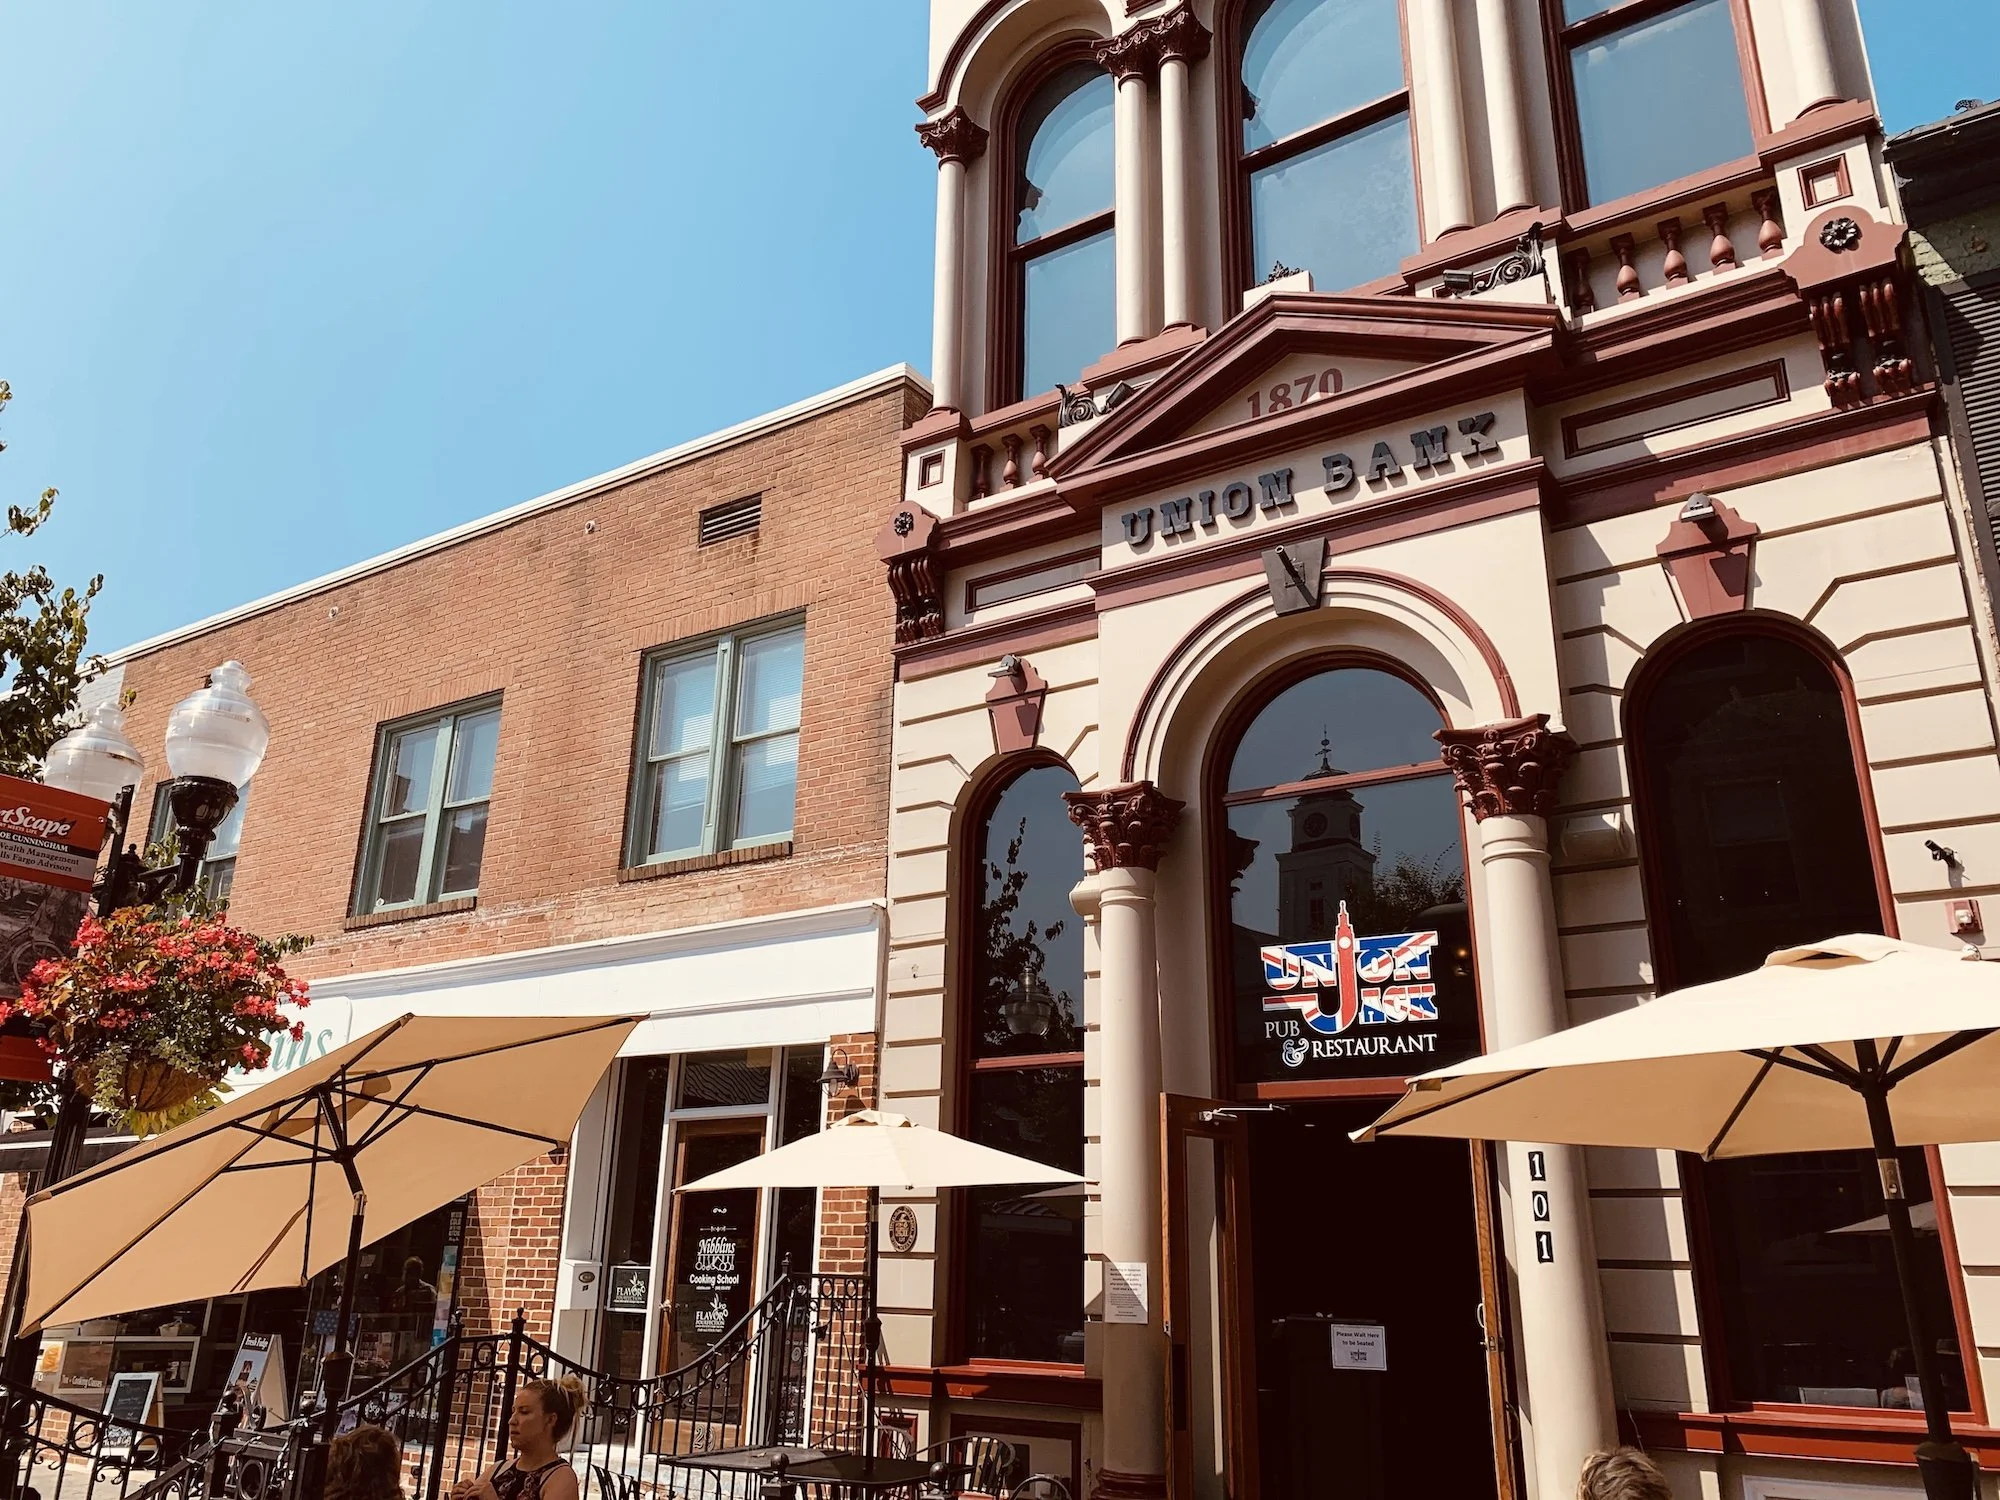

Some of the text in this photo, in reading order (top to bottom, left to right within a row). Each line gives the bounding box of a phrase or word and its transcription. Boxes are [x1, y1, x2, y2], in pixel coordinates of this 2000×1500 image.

[1247, 368, 1343, 419] 1870
[1121, 411, 1499, 548] UNION BANK
[12, 833, 69, 852] CUNNINGHAM
[12, 853, 36, 866] Fargo
[37, 859, 73, 873] Advisors
[26, 847, 79, 866] Management
[1265, 1020, 1300, 1039] PUB
[1282, 1033, 1438, 1067] & RESTAURANT
[1531, 1152, 1552, 1261] 101
[697, 1236, 737, 1254] Nibblins
[689, 1274, 715, 1288] Cooking
[716, 1274, 740, 1284] School
[696, 1310, 725, 1321] FLAVOR
